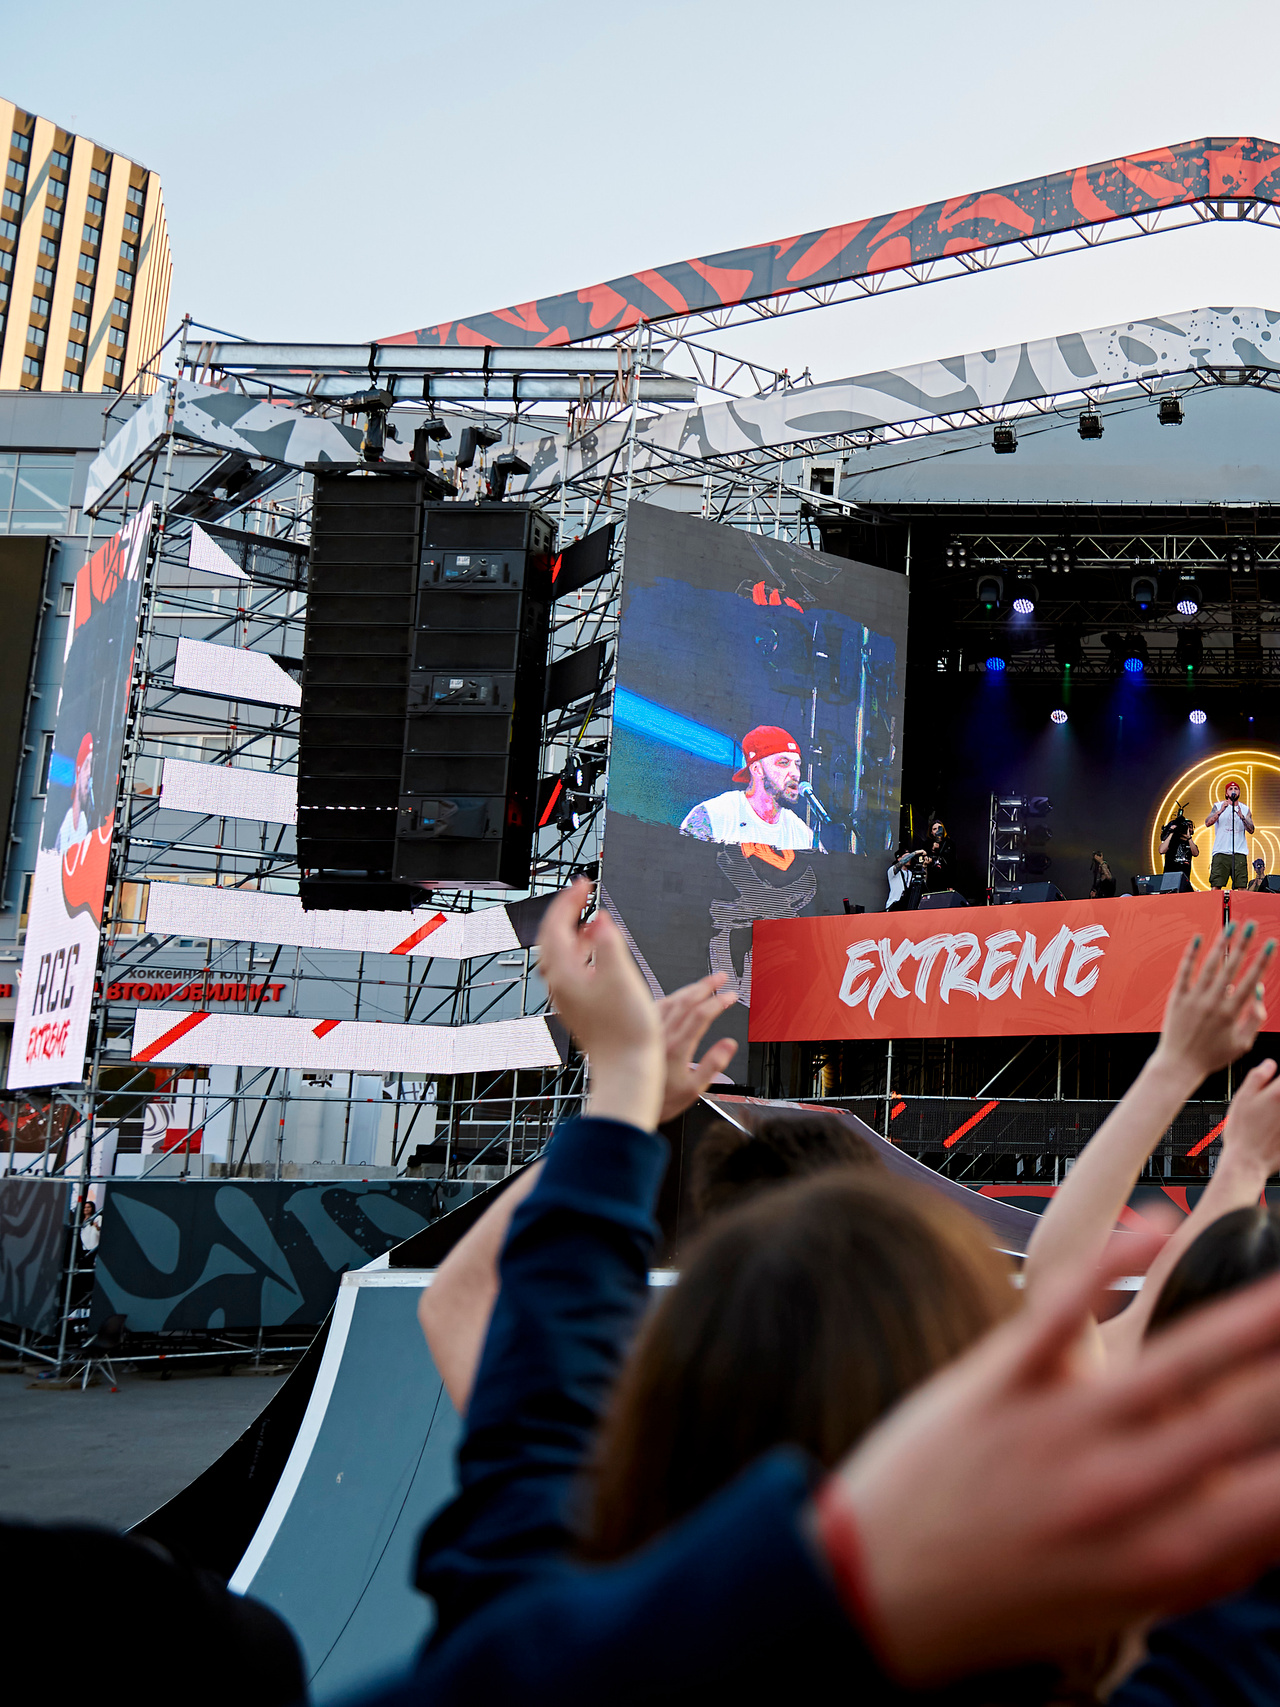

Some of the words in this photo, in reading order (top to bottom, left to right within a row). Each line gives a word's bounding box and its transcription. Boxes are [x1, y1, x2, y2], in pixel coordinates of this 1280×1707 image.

[31, 943, 81, 1016] RCC
[838, 924, 1110, 1020] EXTREME
[26, 1019, 71, 1068] EXTREME
